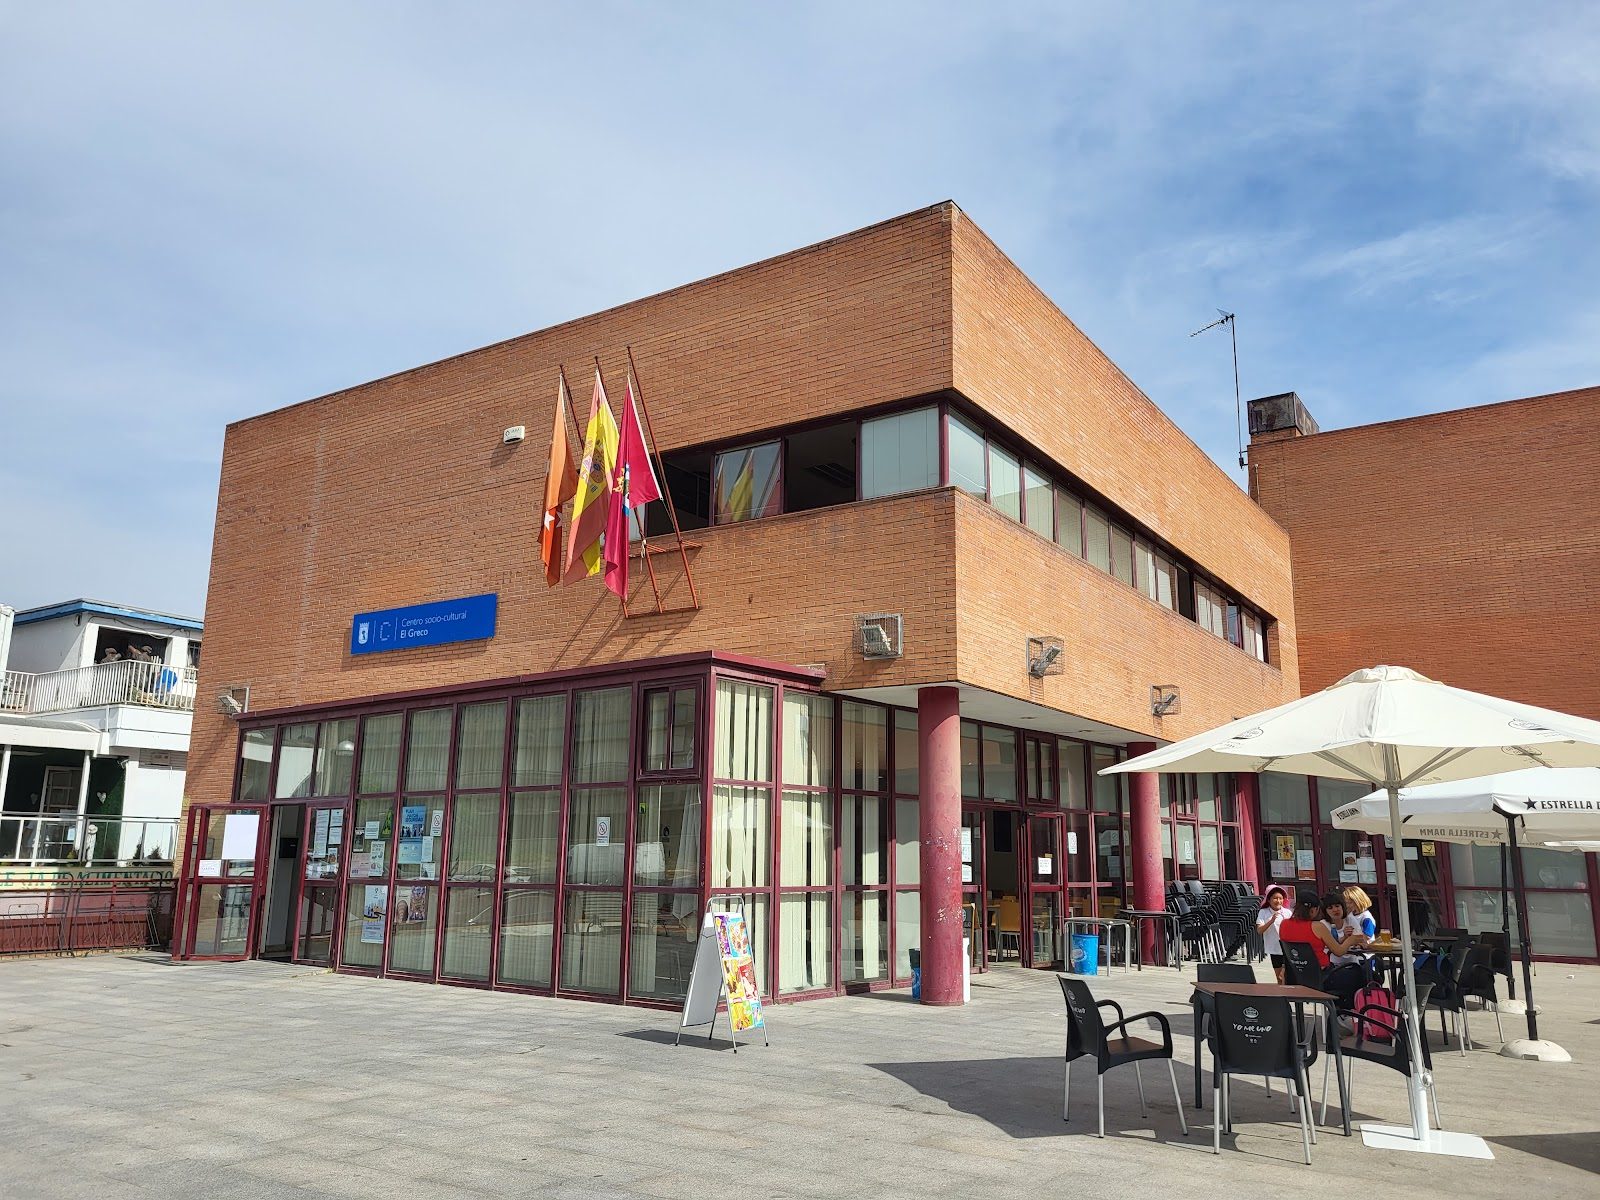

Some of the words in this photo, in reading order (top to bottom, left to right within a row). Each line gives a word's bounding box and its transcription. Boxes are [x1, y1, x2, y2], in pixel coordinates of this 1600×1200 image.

[401, 617, 424, 627] Centro
[424, 610, 468, 624] socio-cultural
[400, 629, 407, 639] El
[408, 628, 428, 638] Greco
[1540, 800, 1593, 810] ESTRELLA
[74, 871, 174, 887] ALIMENTACO
